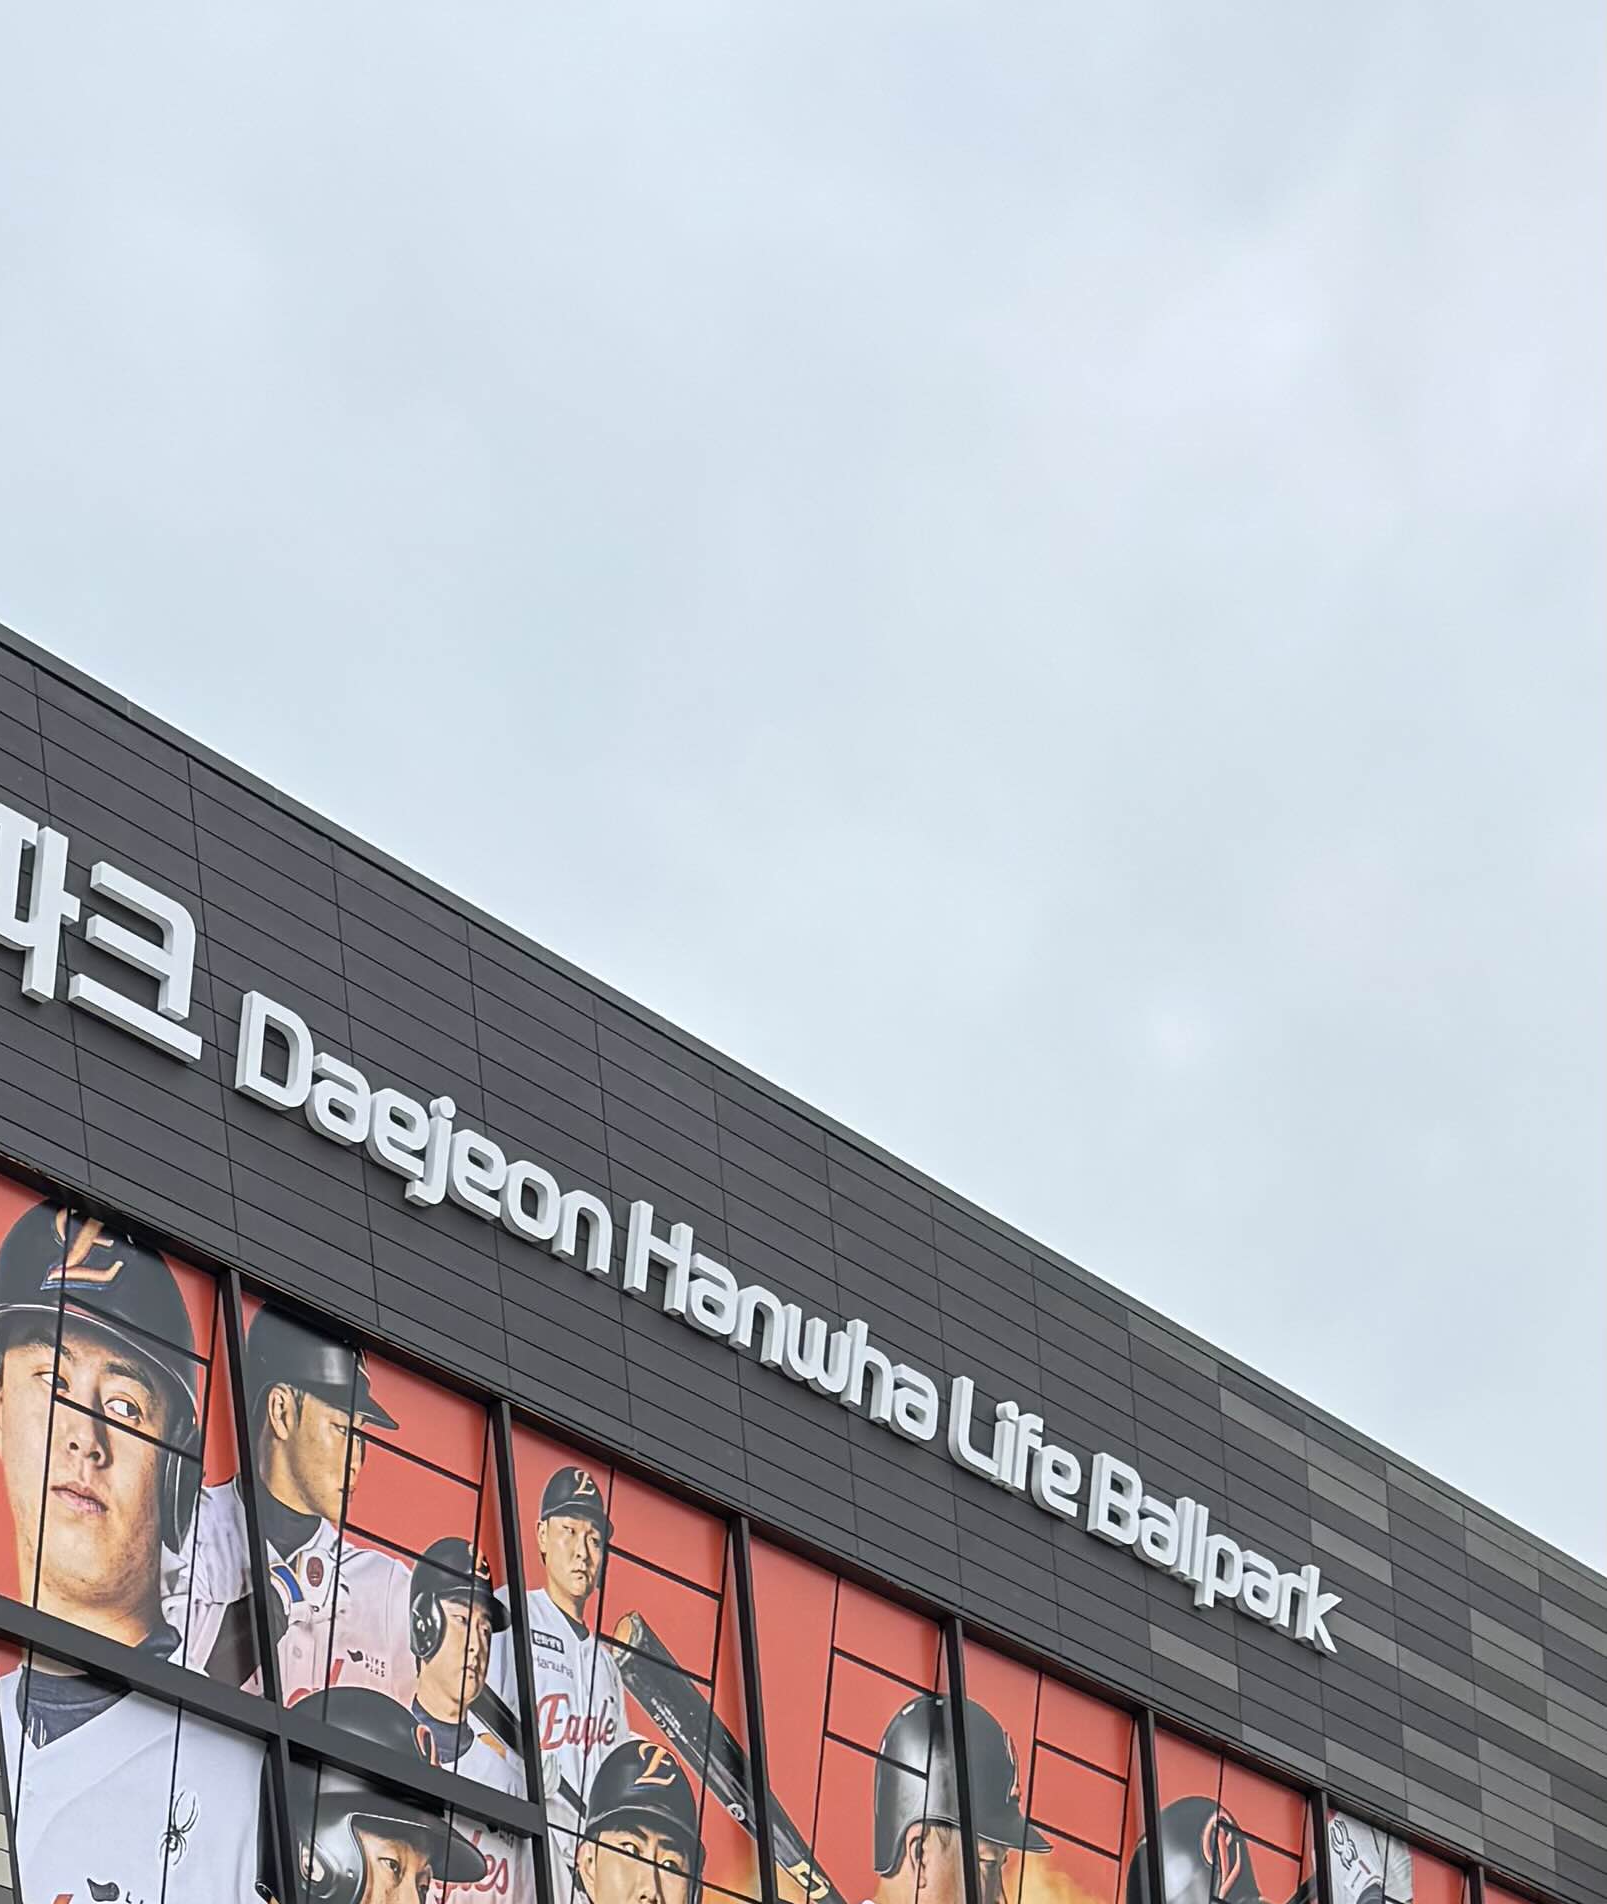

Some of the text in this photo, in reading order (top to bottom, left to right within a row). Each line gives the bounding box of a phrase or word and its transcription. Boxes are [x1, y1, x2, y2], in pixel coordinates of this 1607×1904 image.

[234, 989, 1343, 1656] Daejeon Hanwha Life Ballpark
